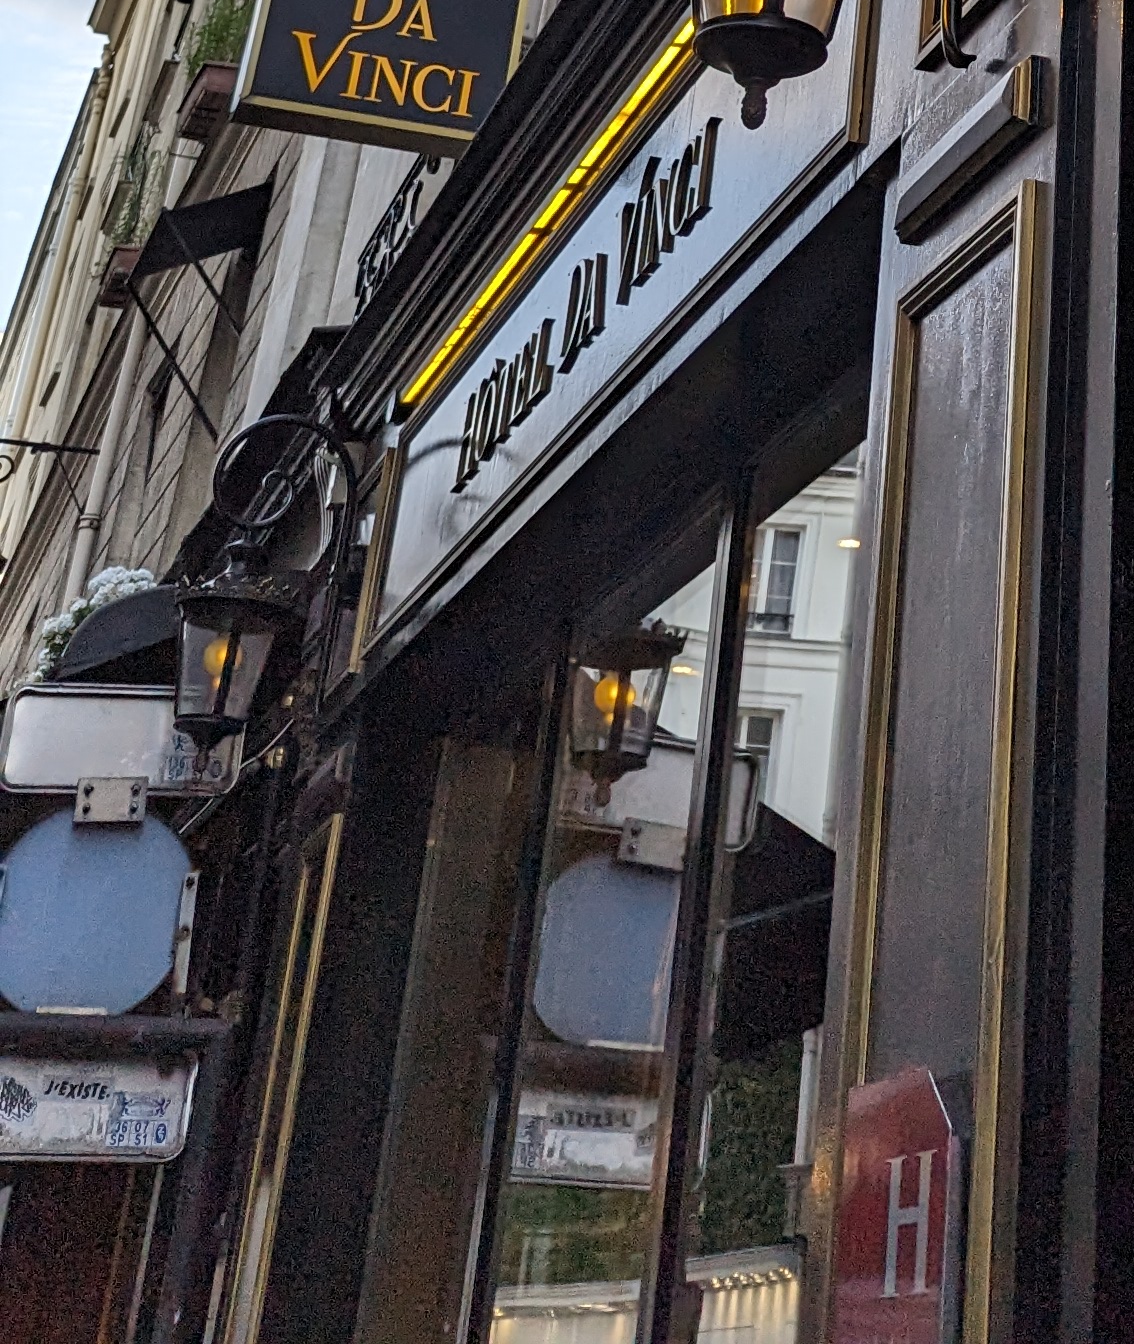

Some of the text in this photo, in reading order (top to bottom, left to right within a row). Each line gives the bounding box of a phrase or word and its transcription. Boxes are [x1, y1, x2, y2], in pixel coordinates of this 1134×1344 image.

[291, 29, 480, 118] VINCI
[558, 252, 609, 374] DA
[616, 116, 723, 306] VINCI
[880, 1149, 937, 1299] H
